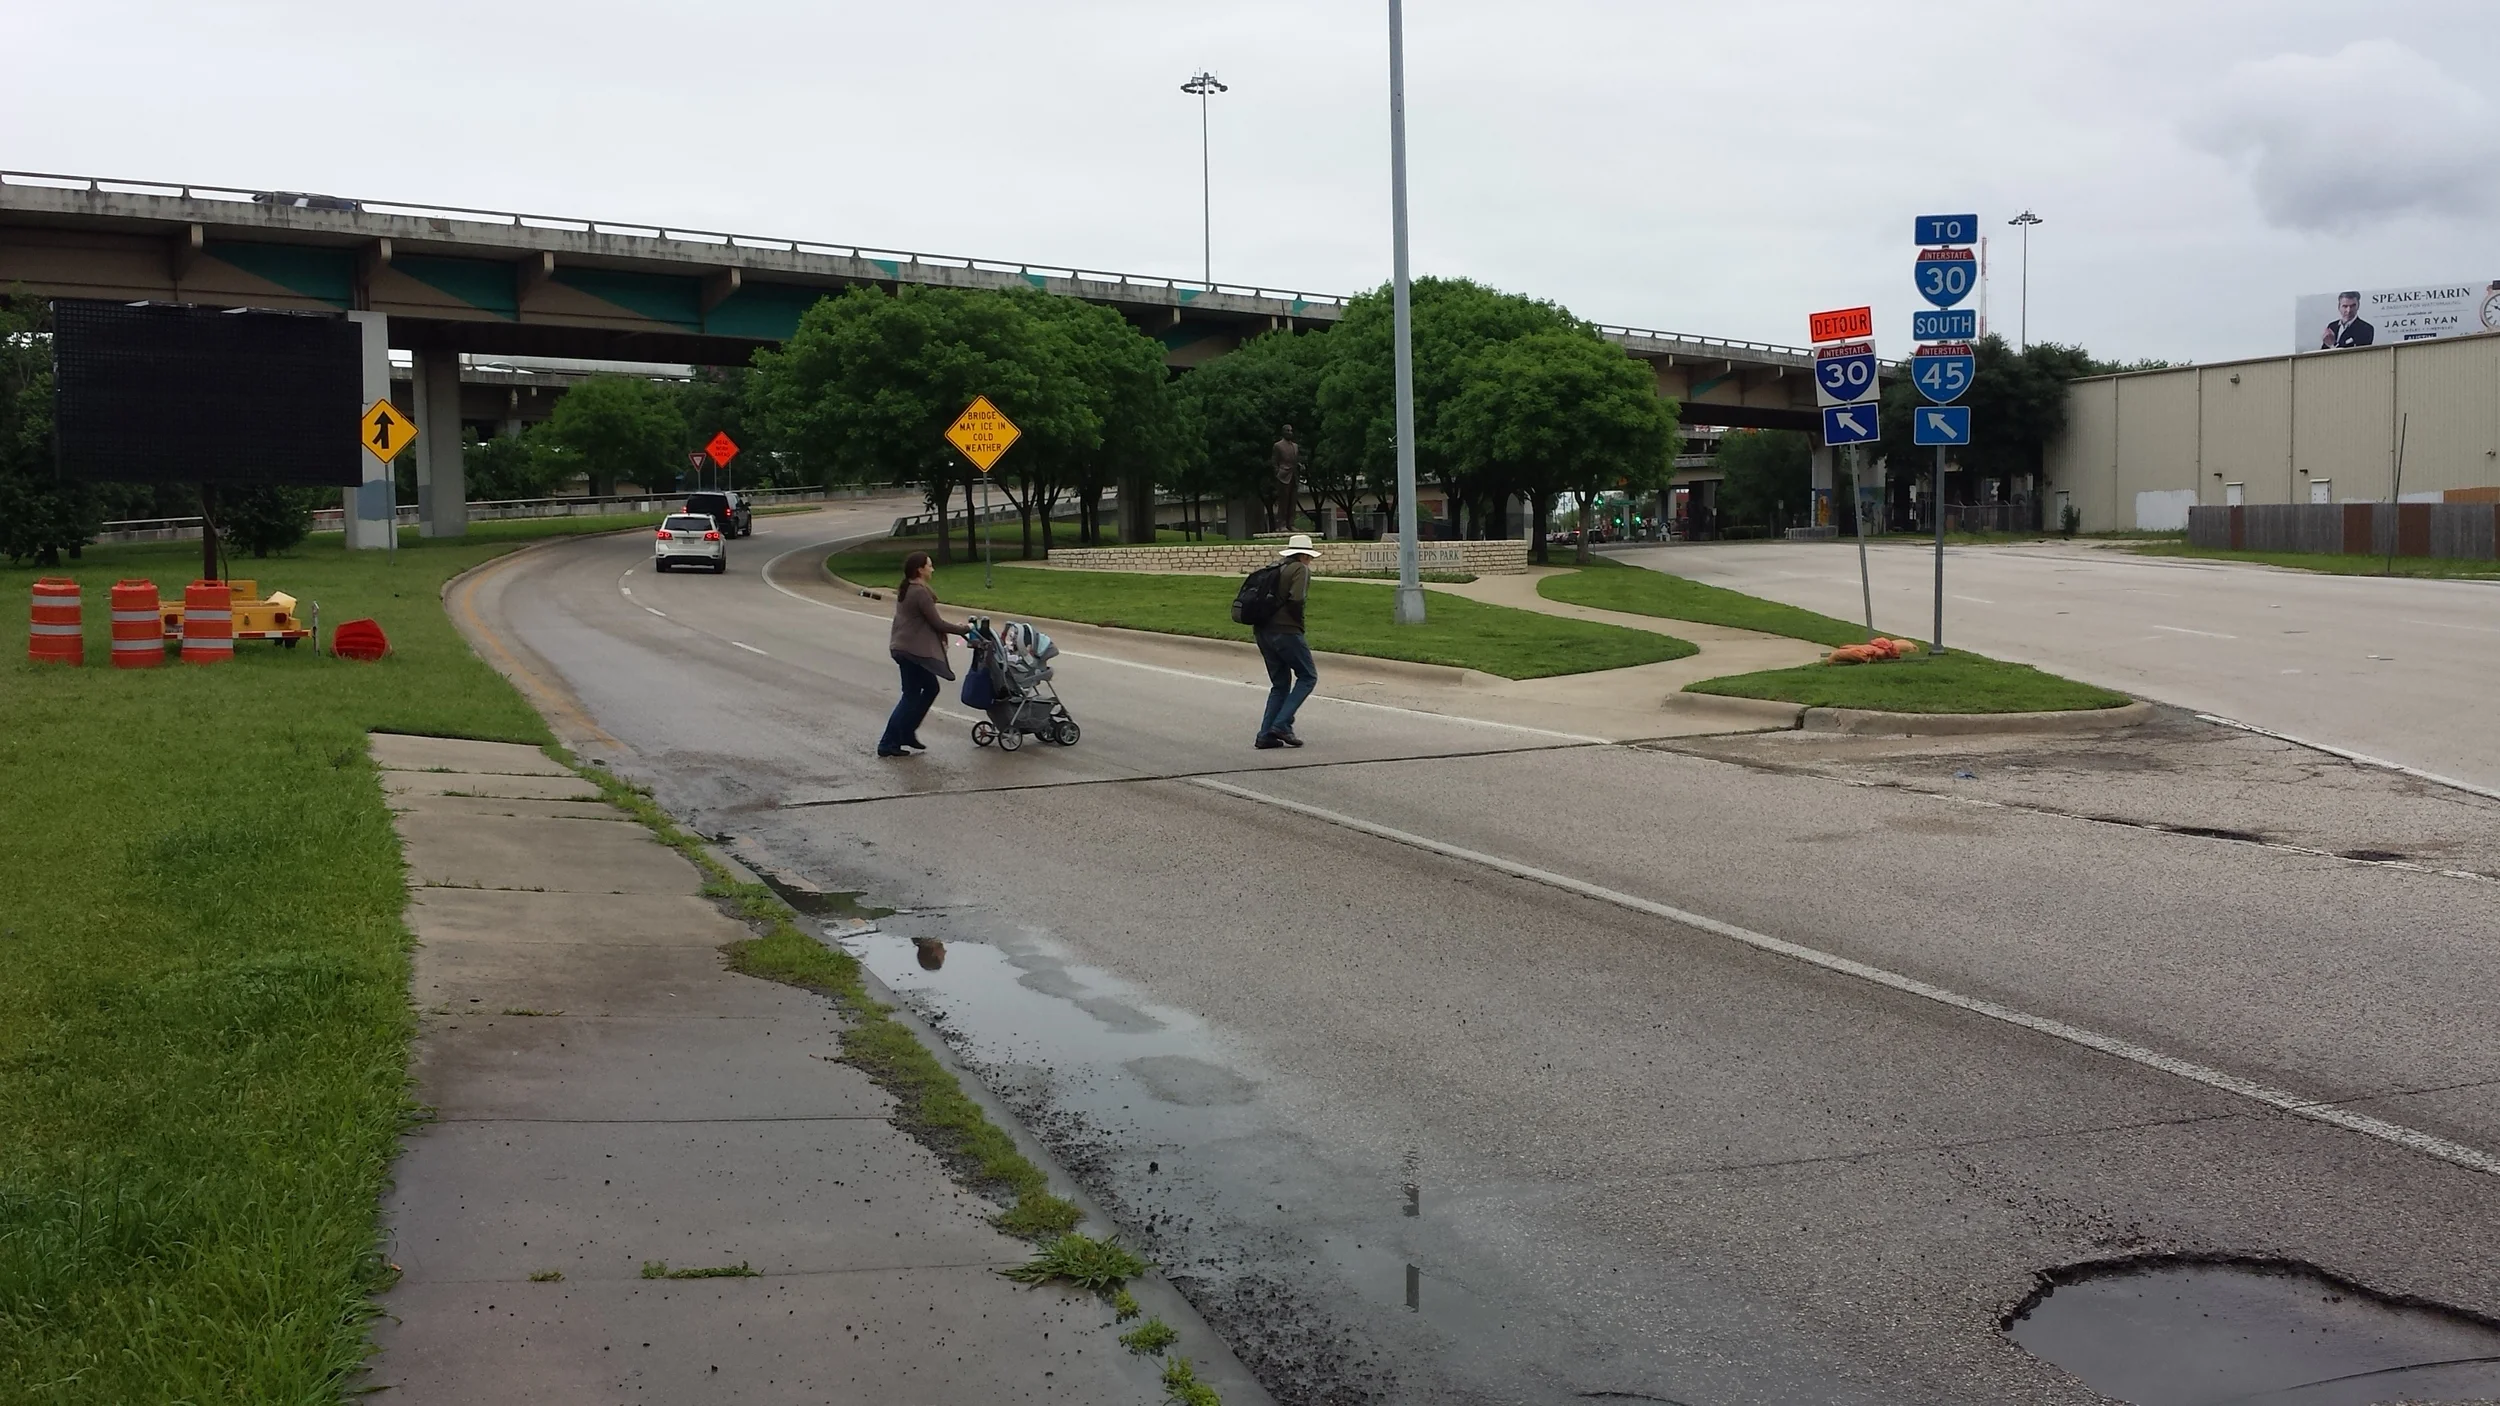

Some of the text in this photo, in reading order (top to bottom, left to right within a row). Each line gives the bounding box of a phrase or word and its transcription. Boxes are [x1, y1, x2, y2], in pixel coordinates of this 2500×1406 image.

[1931, 221, 1961, 239] TO
[1924, 251, 1968, 260] INTERSTATE
[1924, 266, 1966, 295] 30
[2372, 287, 2471, 304] SPEAKE-MARIN
[1814, 314, 1869, 336] DETOUR
[1915, 315, 1972, 335] SOUTH
[2384, 315, 2459, 328] JACK RYAN
[1823, 345, 1866, 357] INTERSTATE
[1922, 346, 1965, 356] INTERSTATE
[1824, 360, 1868, 388] 30
[1921, 362, 1965, 390] 45
[968, 411, 996, 420] BRIDGE
[959, 421, 1006, 431] MAY ICE IN
[973, 433, 993, 441] COLD
[966, 443, 1001, 452] WEATHER
[1364, 551, 1398, 563] JULIUS
[1439, 549, 1460, 561] PARK
